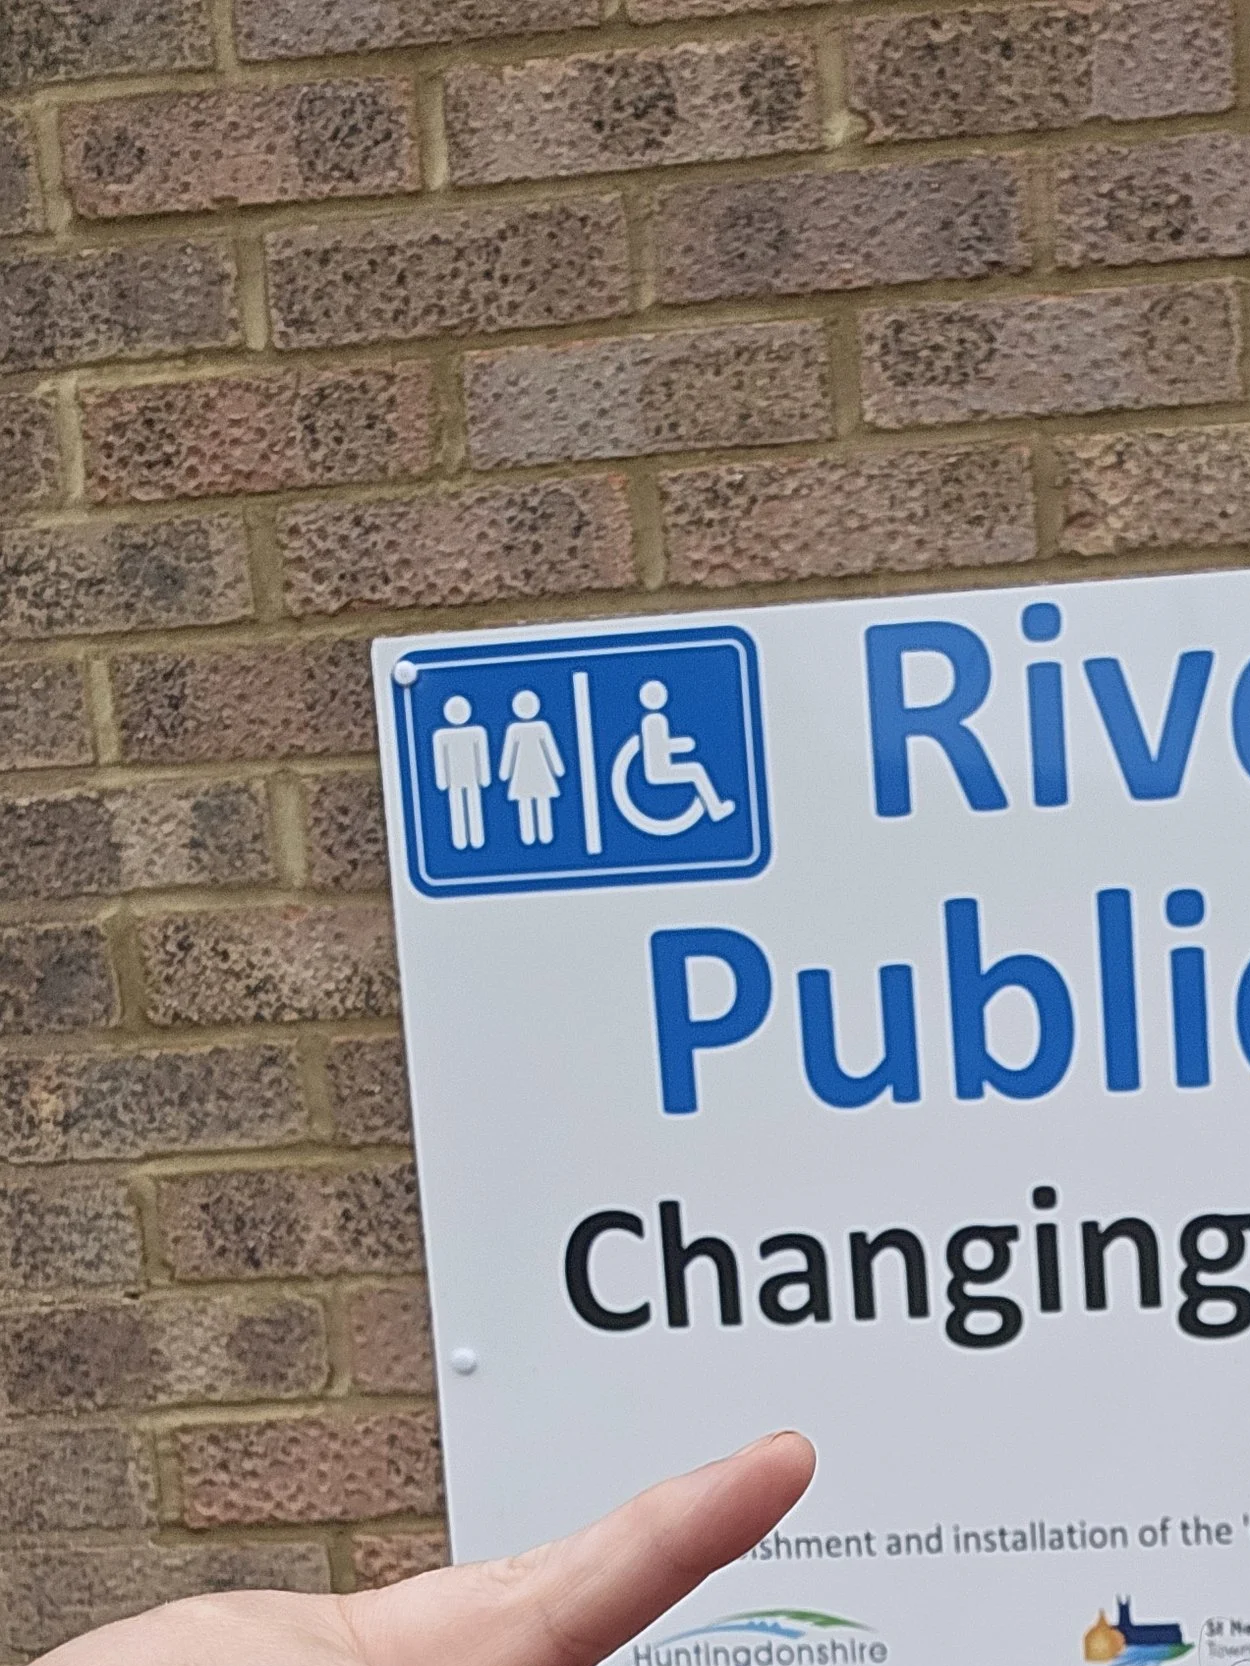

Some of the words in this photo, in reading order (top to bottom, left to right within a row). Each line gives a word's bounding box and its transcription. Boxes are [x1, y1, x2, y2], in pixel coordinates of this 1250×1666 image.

[741, 1529, 877, 1560] shment
[885, 1523, 943, 1556] and
[953, 1519, 1129, 1554] installation
[1138, 1515, 1171, 1548] of
[1180, 1514, 1233, 1547] the
